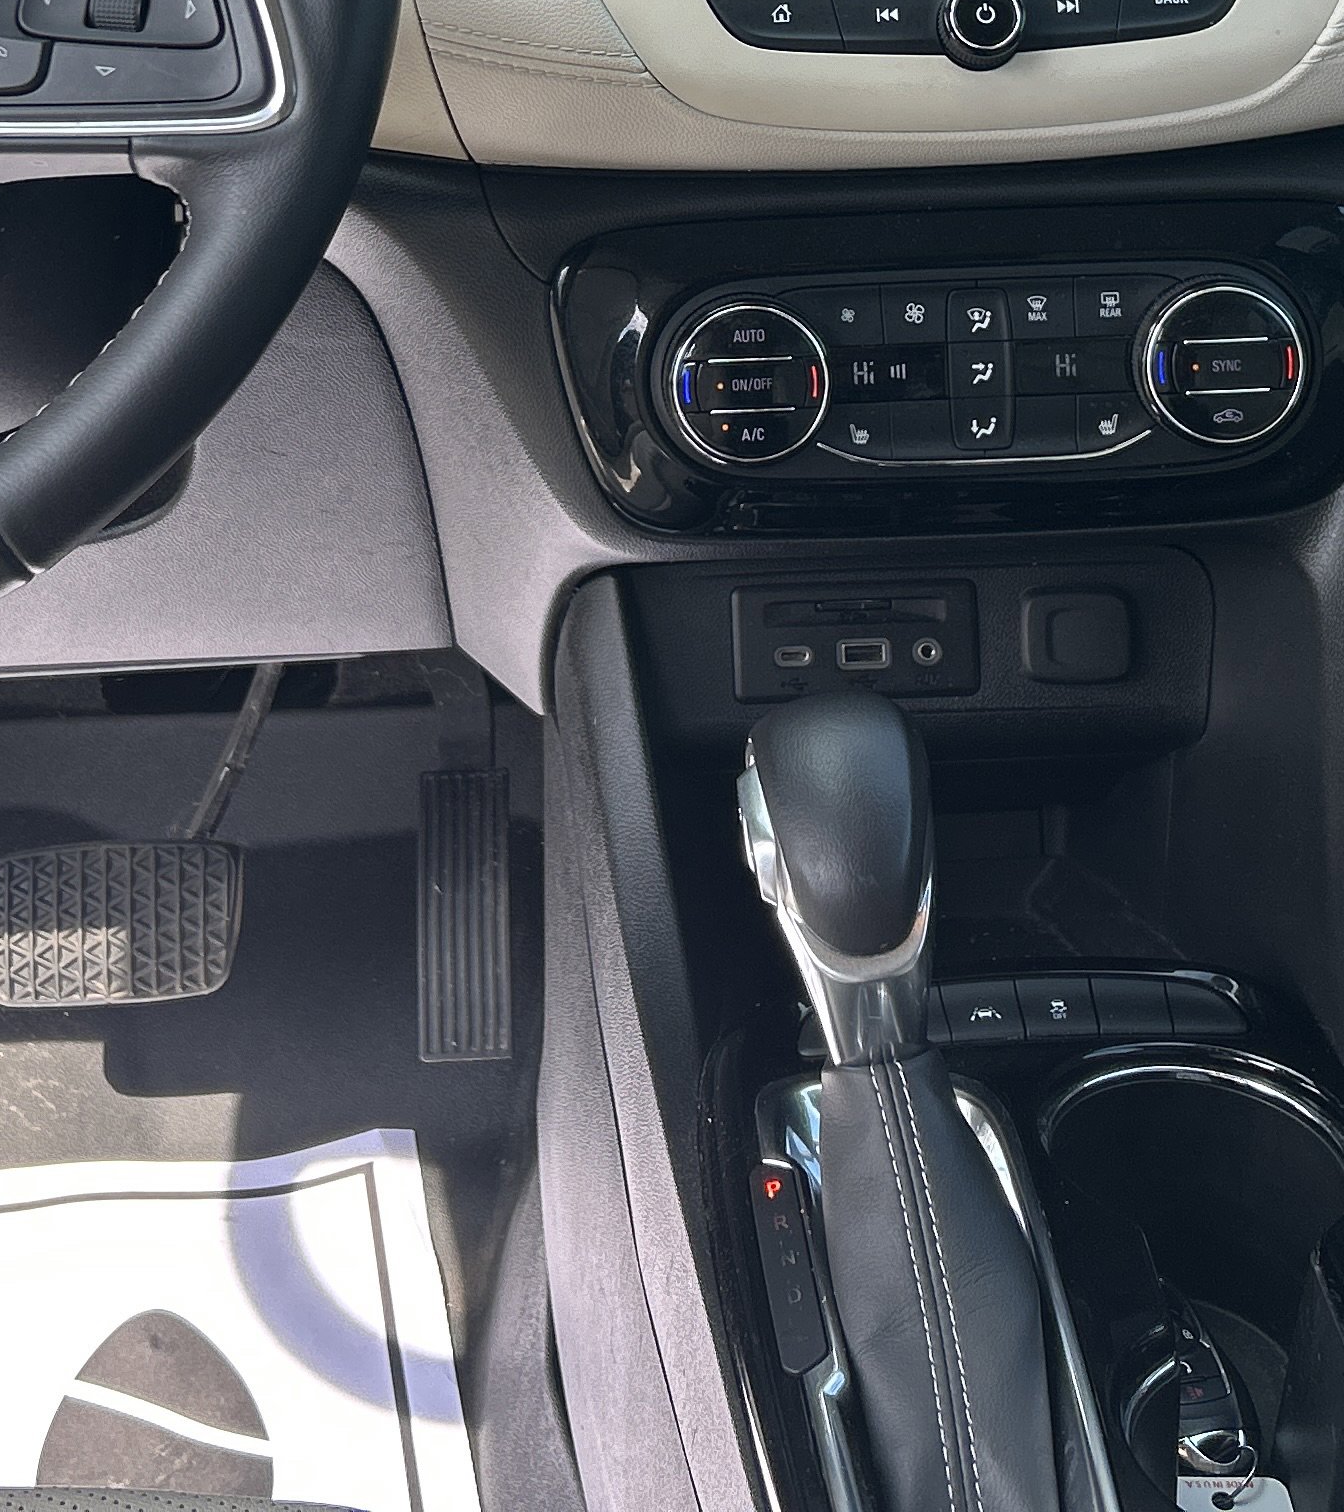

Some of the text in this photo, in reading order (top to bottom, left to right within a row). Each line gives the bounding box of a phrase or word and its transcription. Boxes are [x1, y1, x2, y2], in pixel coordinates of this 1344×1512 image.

[1027, 311, 1048, 322] MAX
[1099, 308, 1122, 318] REAR
[733, 329, 766, 343] AUTO
[853, 361, 875, 385] Hi
[1211, 359, 1242, 373] SYNC
[731, 377, 773, 391] ON/OFF
[741, 427, 765, 441] A/C
[766, 1180, 781, 1199] P
[774, 1215, 789, 1231] R
[781, 1250, 796, 1267] N
